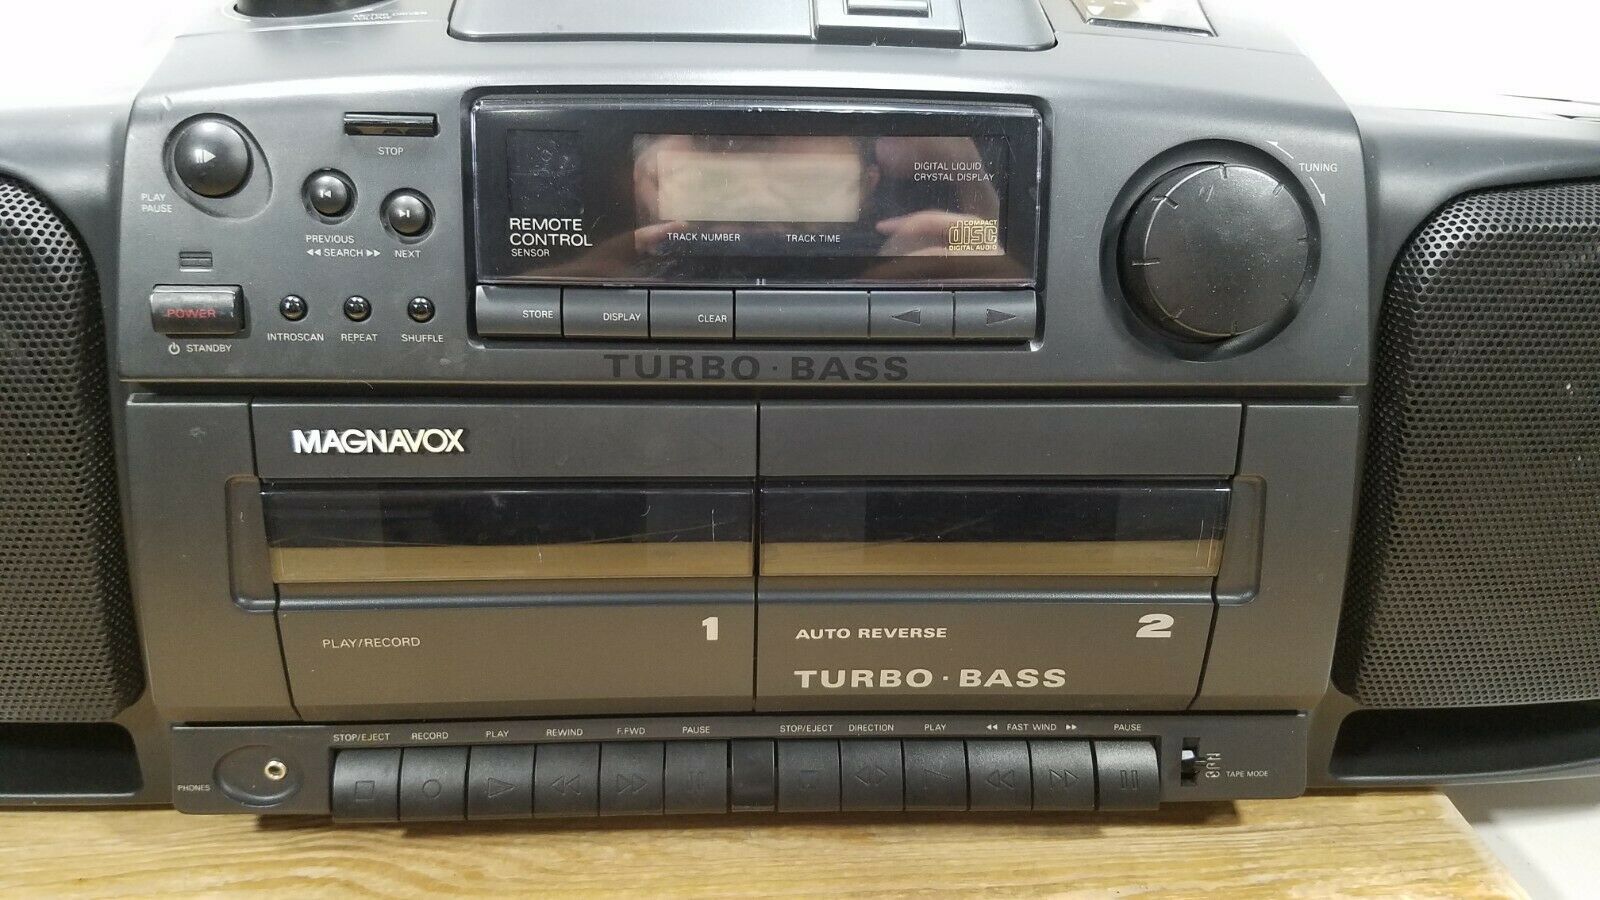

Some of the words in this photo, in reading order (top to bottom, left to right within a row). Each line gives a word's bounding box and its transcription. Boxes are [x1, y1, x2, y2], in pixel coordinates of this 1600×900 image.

[377, 146, 405, 156] STOP
[913, 161, 949, 171] DIGITAL
[951, 161, 982, 171] LIQUID
[1299, 162, 1338, 173] TUNING
[913, 172, 954, 182] CRYSTAL
[957, 172, 995, 182] DISPLAY
[141, 193, 166, 202] PLAY
[141, 203, 173, 213] PAUSE
[509, 218, 583, 231] REMOTE
[305, 234, 355, 244] PREVIOUS
[509, 233, 593, 247] CONTROL
[667, 232, 698, 241] TRACK
[701, 232, 741, 242] NUMBER
[786, 233, 816, 243] TRACK
[819, 234, 841, 243] TIME
[323, 248, 363, 258] SEARCH
[394, 250, 422, 259] NEXT
[511, 248, 550, 258] SENSOR
[167, 308, 217, 319] POWER
[522, 309, 554, 319] STORE
[602, 312, 642, 322] DISPLAY
[697, 314, 728, 323] CLEAR
[267, 332, 325, 343] INTROSCAN
[341, 333, 378, 343] REPEAT
[401, 334, 444, 344] SHUFFLE
[186, 343, 233, 353] STANDBY
[603, 354, 761, 381] TURBO
[790, 355, 910, 381] BASS
[291, 428, 466, 455] MAGNAVOX
[702, 616, 719, 641] 1
[1135, 613, 1175, 638] 2
[795, 628, 851, 640] AUTO
[858, 627, 948, 639] REVERSE
[322, 637, 421, 649] PLAY/RECORD
[794, 669, 932, 689] TURBO
[959, 668, 1067, 688] BASS
[616, 726, 646, 736] F.FWD
[682, 725, 711, 735] PAUSE
[779, 723, 834, 733] STOP/EJECT
[847, 722, 895, 732] DIRECTION
[924, 722, 947, 733] PLAY
[1006, 722, 1028, 732] FAST
[1033, 722, 1057, 732] WIND
[1113, 722, 1142, 732] PAUSE
[333, 732, 391, 743] STOP/EJECT
[411, 730, 449, 741] RECORD
[485, 729, 509, 739] PLAY
[545, 728, 584, 738] REWIND
[1225, 770, 1245, 778] TAPE
[1246, 770, 1269, 778] MODE
[177, 783, 211, 793] PHONES
